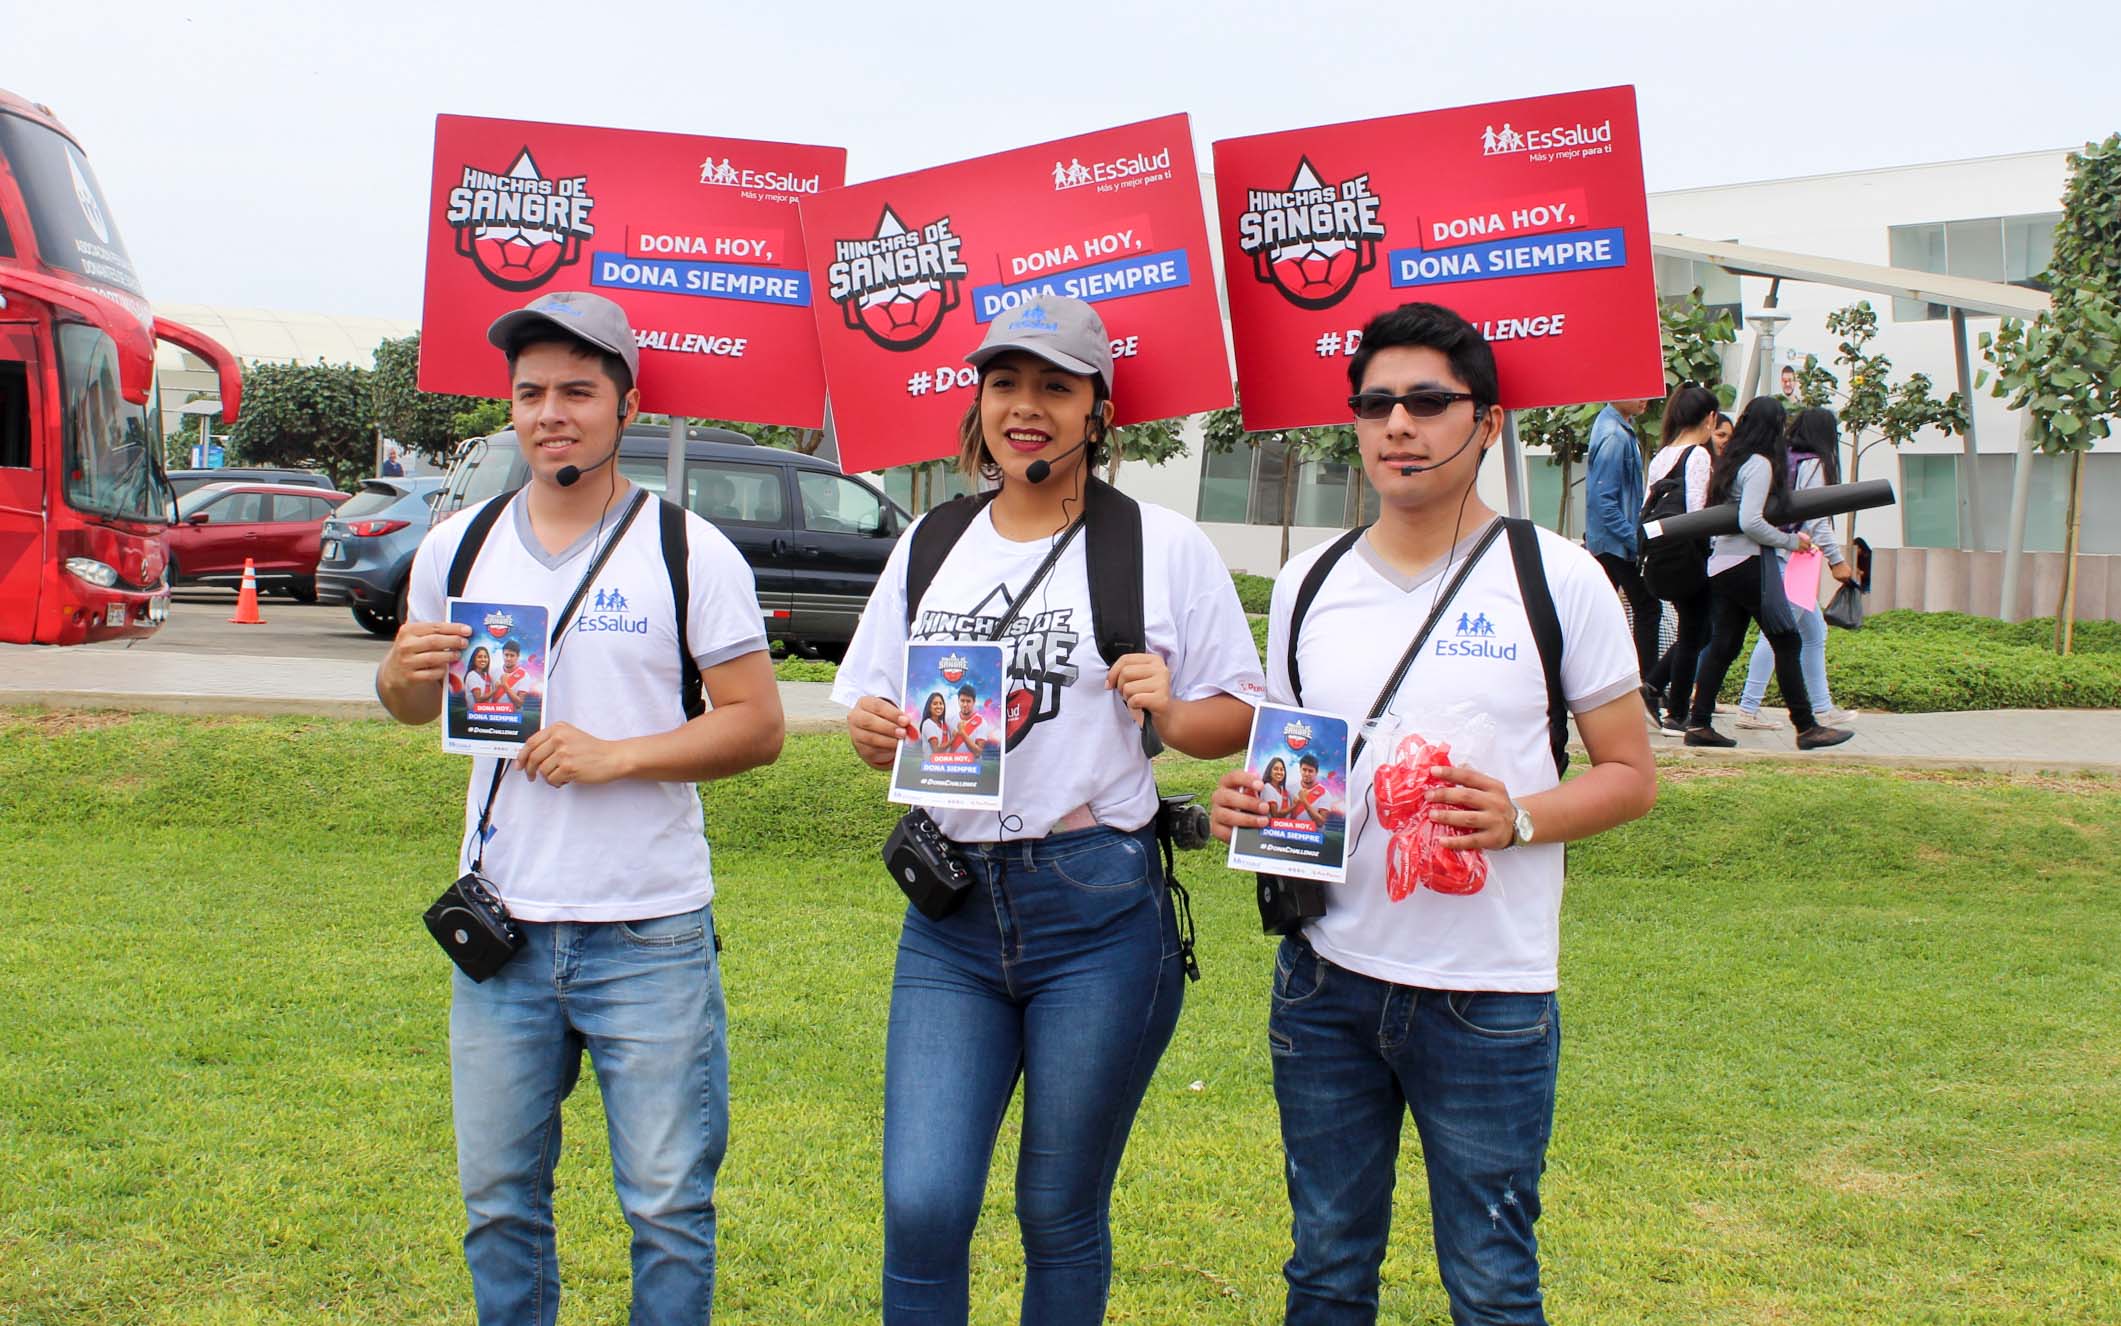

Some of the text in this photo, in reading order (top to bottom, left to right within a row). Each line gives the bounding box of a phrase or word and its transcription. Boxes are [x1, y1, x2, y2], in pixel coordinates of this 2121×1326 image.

[1526, 120, 1611, 150] EsSalud
[1093, 147, 1170, 182] EsSalud
[1529, 144, 1612, 162] Más y mejor para ti
[462, 167, 587, 197] HINCHAS DE
[741, 169, 819, 193] EsSalud
[1097, 170, 1172, 193] Más y mejor para ti
[1249, 175, 1371, 212] HINCHAS DE
[447, 187, 594, 235] SANGRE
[741, 190, 757, 199] Más
[765, 194, 788, 203] mejor
[1240, 197, 1385, 250] SANGRE
[1432, 203, 1576, 241] DONA HOY,
[640, 234, 773, 260] DONA HOY,
[836, 218, 952, 262] HINCHAS DE
[1012, 230, 1142, 275] DONA HOY,
[829, 237, 967, 300] SANGRE
[1401, 239, 1612, 280] DONA SIEMPRE
[603, 262, 799, 298] DONA SIEMPRE
[1065, 261, 1176, 299] SIEMPRE
[632, 328, 748, 357] HALLENGE
[578, 614, 648, 634] EsSalud
[918, 610, 1030, 635] HINCHS
[1435, 639, 1517, 661] EsSalud
[489, 714, 519, 722] SIEMPRE
[923, 764, 977, 773] DONA SIEMPRE
[1263, 828, 1320, 842] DONA SIEMPRE
[1273, 820, 1294, 828] DONA
